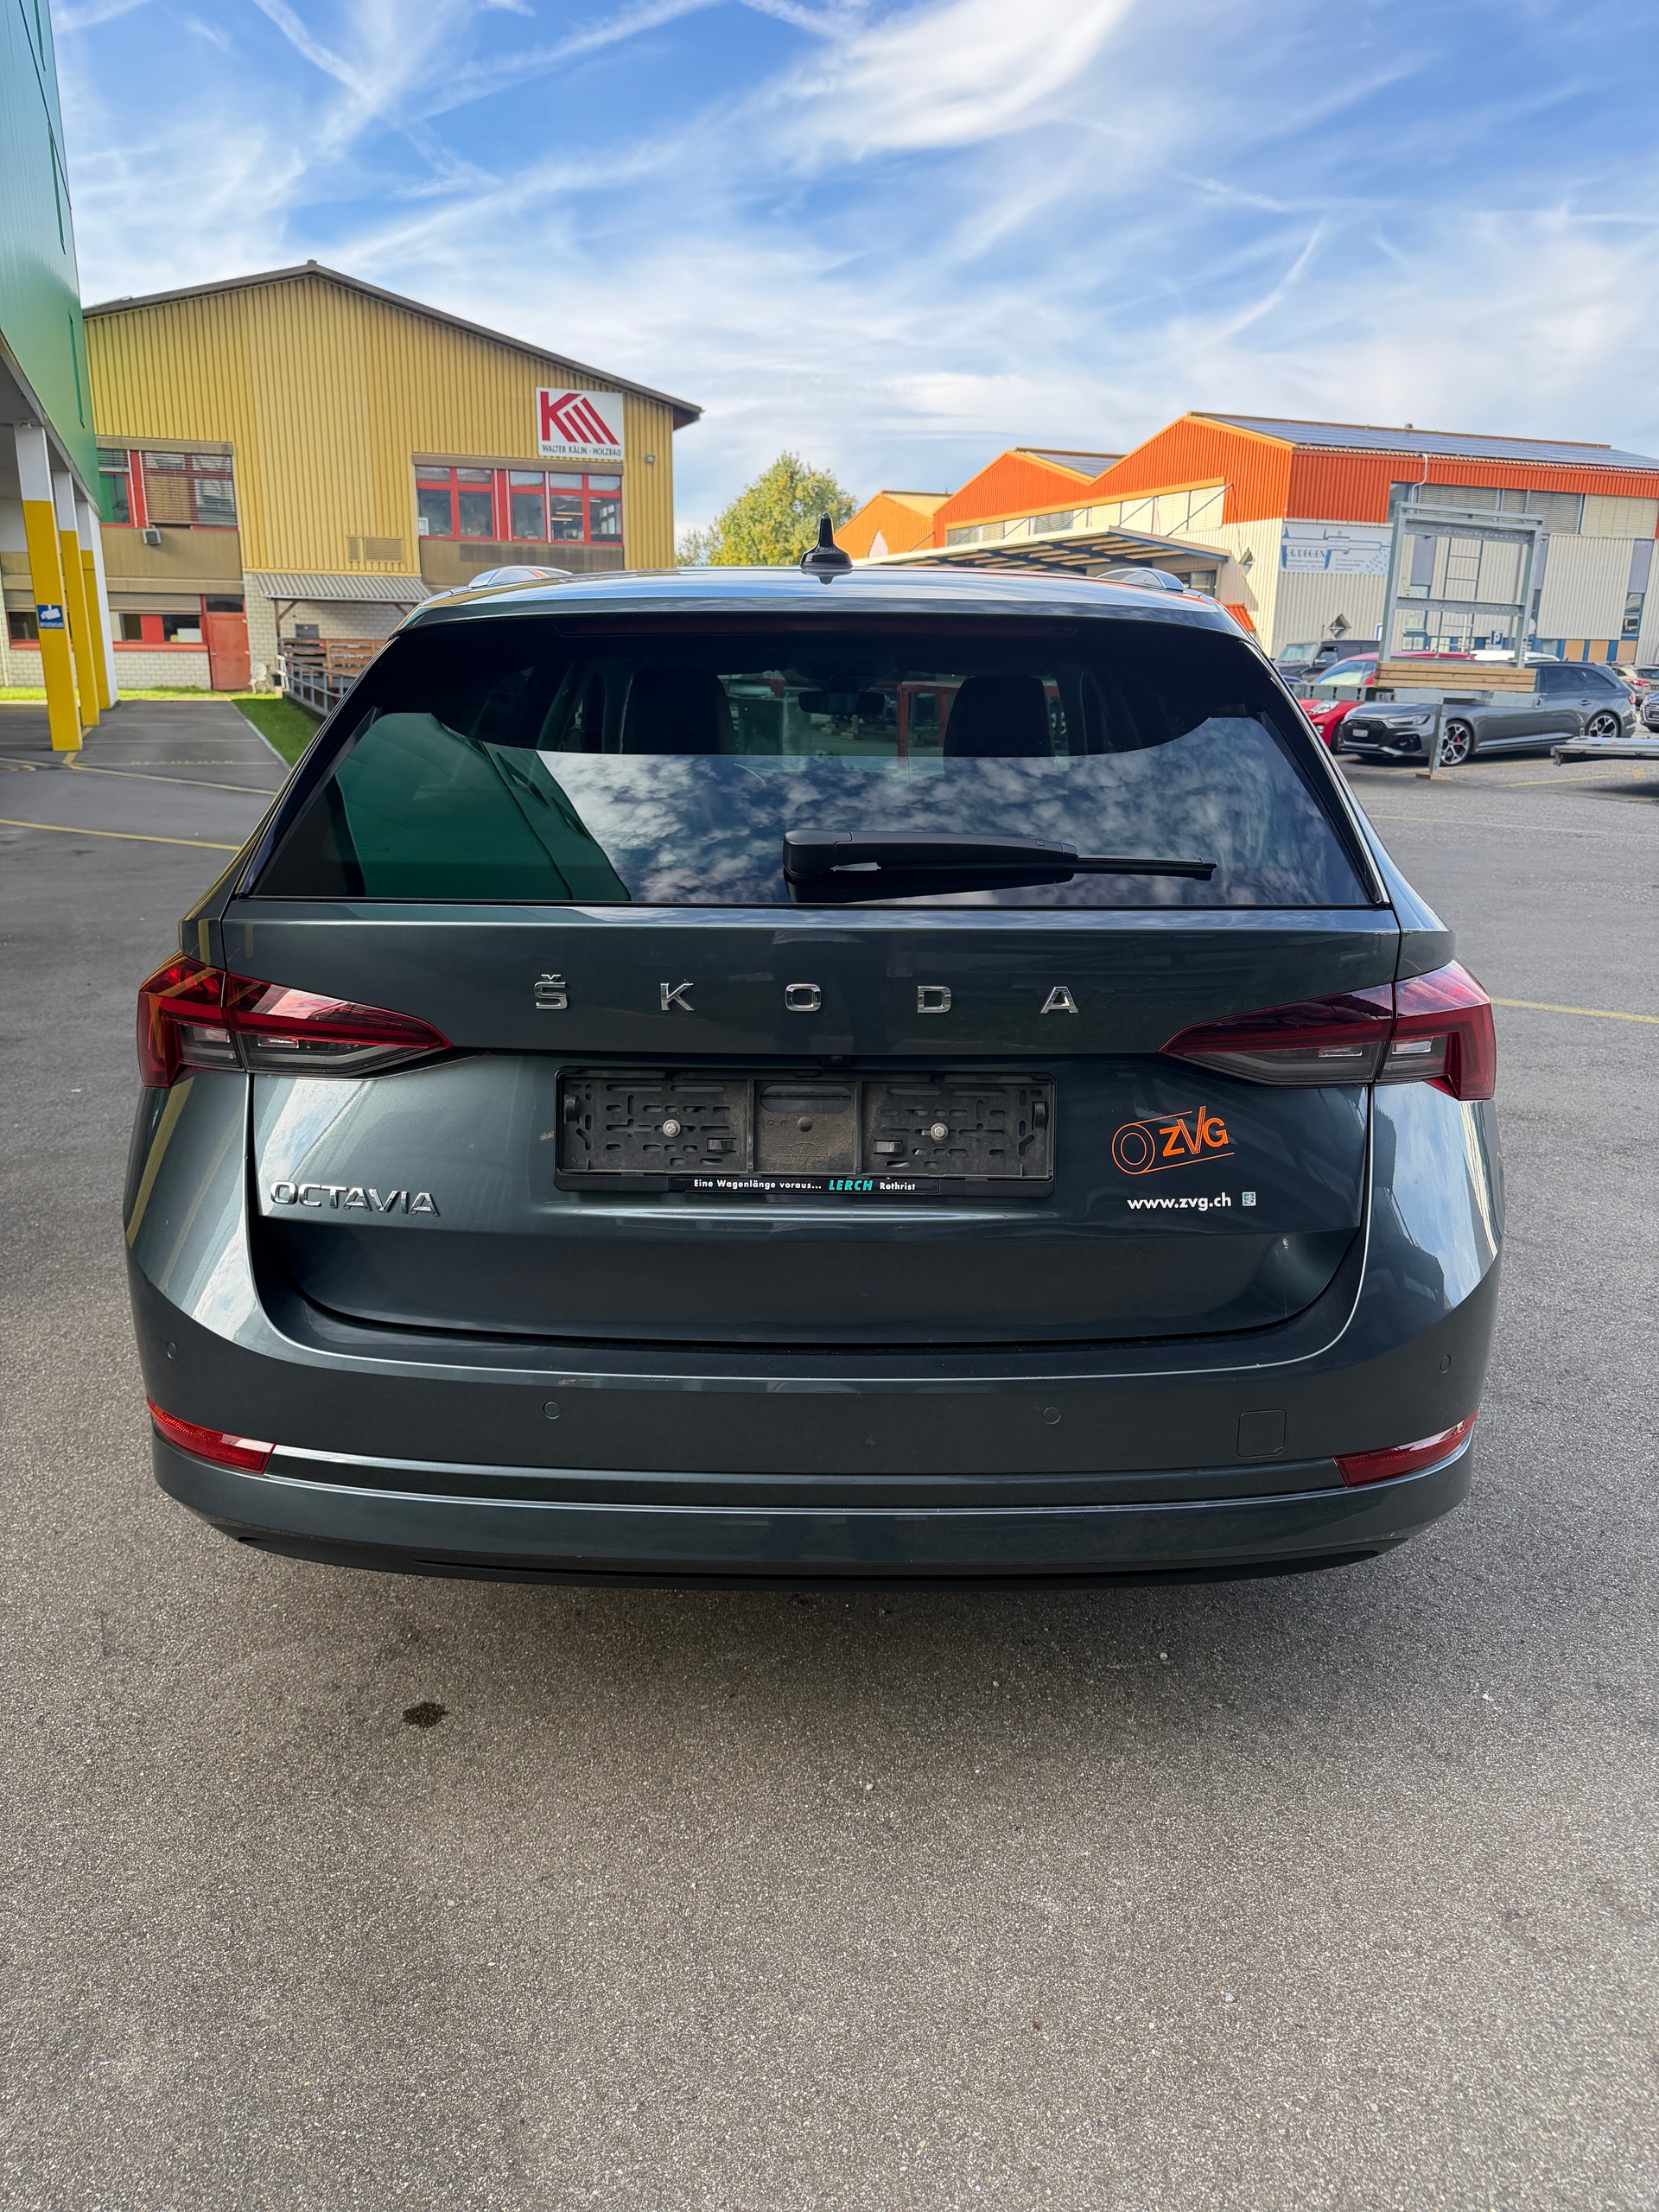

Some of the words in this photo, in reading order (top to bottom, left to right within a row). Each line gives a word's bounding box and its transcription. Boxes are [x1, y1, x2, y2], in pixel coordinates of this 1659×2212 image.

[542, 444, 567, 454] WALTER
[593, 448, 622, 457] HOLZBAU
[534, 974, 1078, 1014] ŠKODA
[1160, 1106, 1229, 1157] ZVG
[270, 1180, 442, 1217] OCTAVIA
[694, 1179, 714, 1188] Eine
[716, 1179, 777, 1190] Wagenlänge
[779, 1181, 822, 1190] voraus...
[829, 1179, 874, 1191] LERCH
[880, 1181, 916, 1191] Rothrist
[1127, 1192, 1232, 1211] www.zvg.ch
